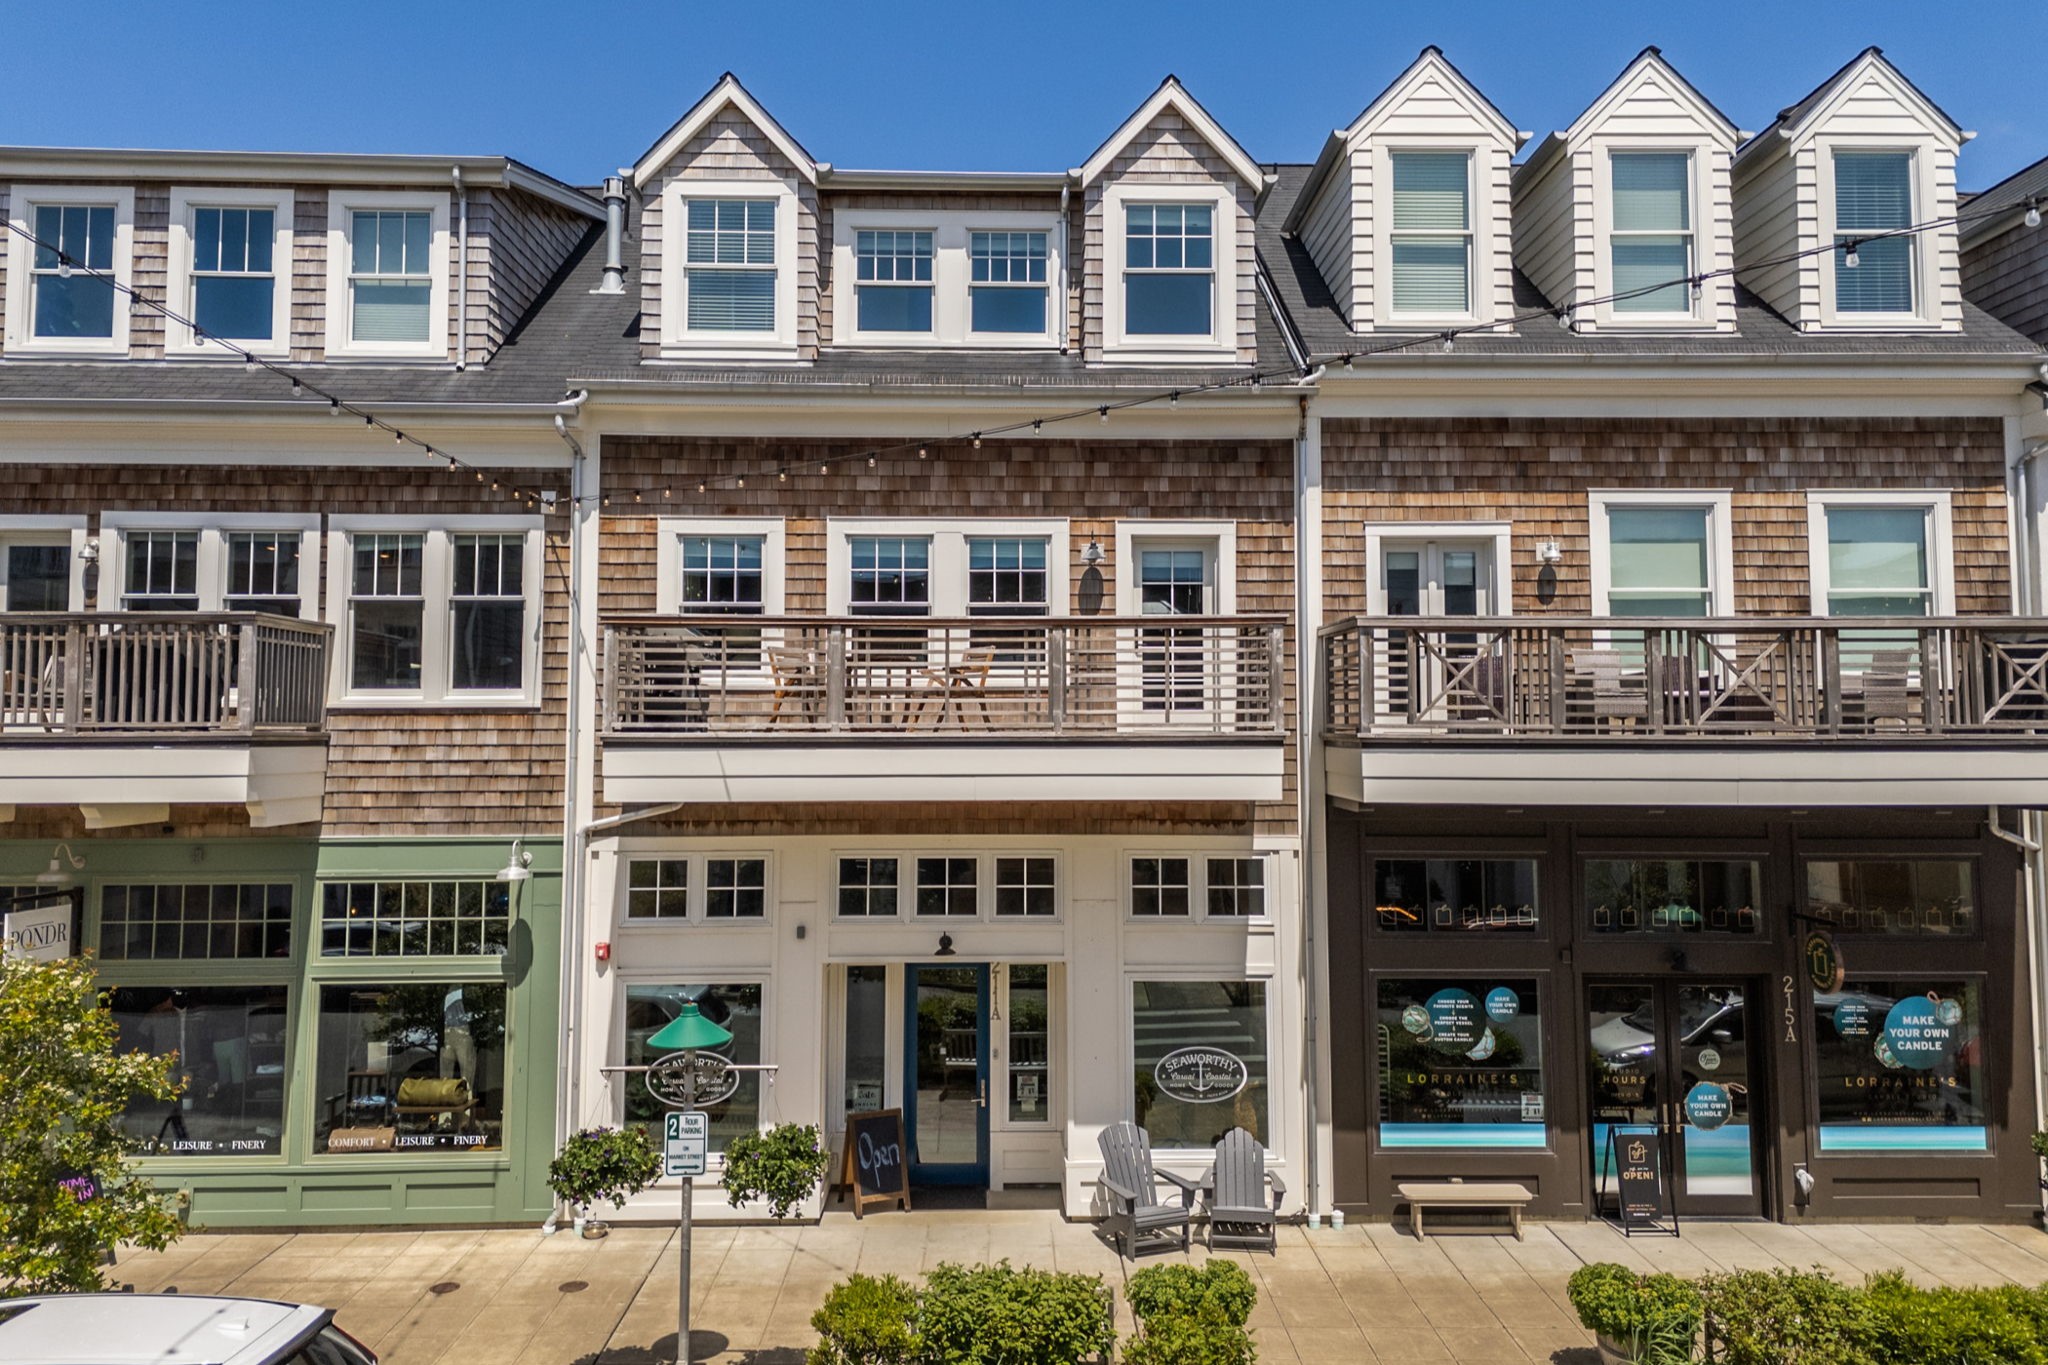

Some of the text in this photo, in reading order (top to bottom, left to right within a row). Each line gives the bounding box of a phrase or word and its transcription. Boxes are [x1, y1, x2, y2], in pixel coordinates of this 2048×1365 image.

[10, 922, 67, 951] PONDR
[1782, 975, 1797, 1042] 215A
[1903, 1015, 1935, 1025] MAKE
[1889, 1028, 1949, 1038] YOUR OWN
[1897, 1041, 1943, 1050] CANDLE
[1165, 1053, 1238, 1072] SEAWORTHY
[1170, 1072, 1231, 1081] Casual Coastal
[1407, 1073, 1518, 1084] LORRAINE'S
[1602, 1075, 1646, 1084] HOURS
[1845, 1076, 1957, 1087] LORRAINE'S
[669, 1118, 678, 1136] 2
[681, 1126, 703, 1135] PARKING
[172, 1140, 267, 1150] LEISURE FINERY
[328, 1135, 488, 1147] COMFORT LEISURE FINERY
[858, 1131, 900, 1188] Open
[1623, 1171, 1654, 1180] OPEN!
